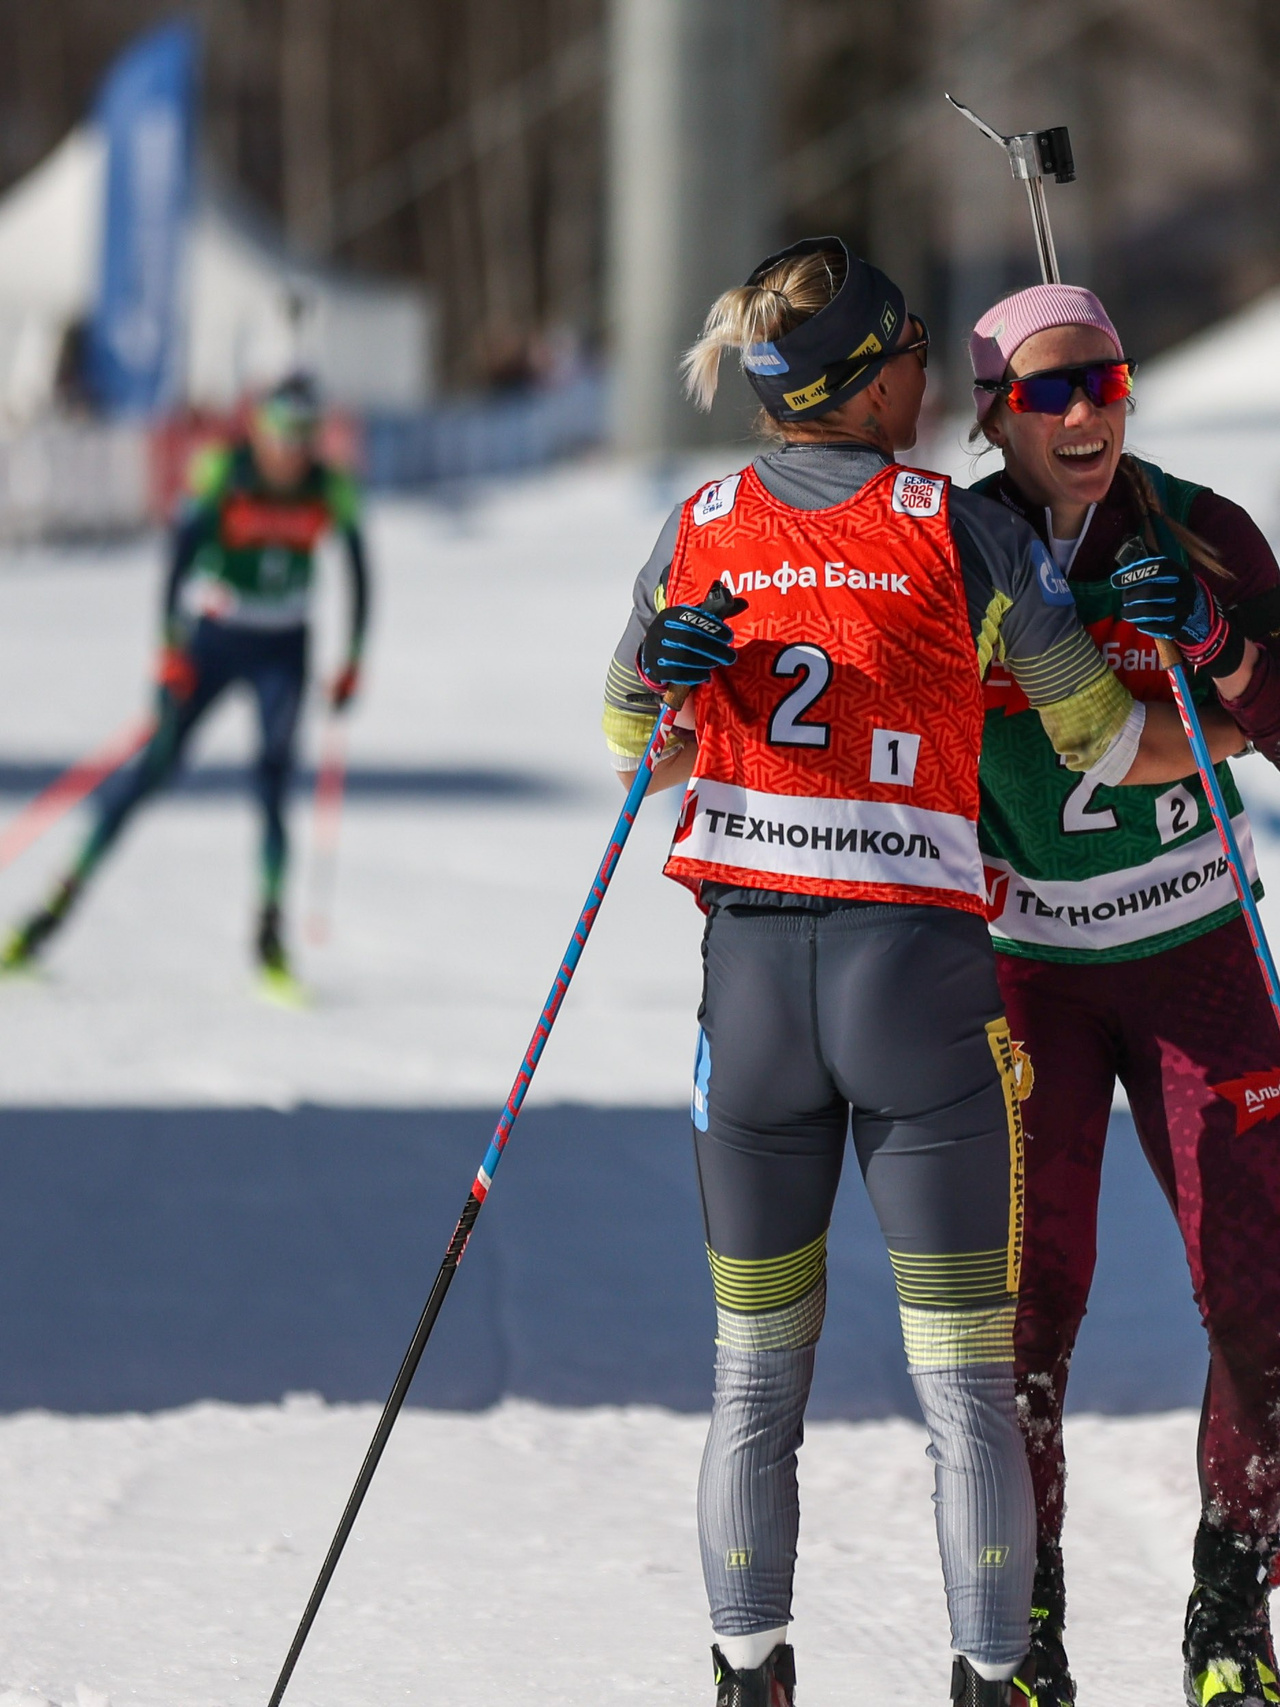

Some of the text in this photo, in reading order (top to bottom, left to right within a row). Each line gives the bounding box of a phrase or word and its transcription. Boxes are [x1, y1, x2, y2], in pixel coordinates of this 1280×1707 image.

[901, 493, 933, 509] 2026
[902, 484, 934, 497] 2025
[718, 560, 912, 597] Альфа Банк
[1121, 564, 1160, 584] KV+
[766, 641, 834, 749] 2
[887, 739, 900, 776] 1
[705, 808, 941, 861] ТЕХНОНИКОЛЬ
[1169, 797, 1189, 835] 2
